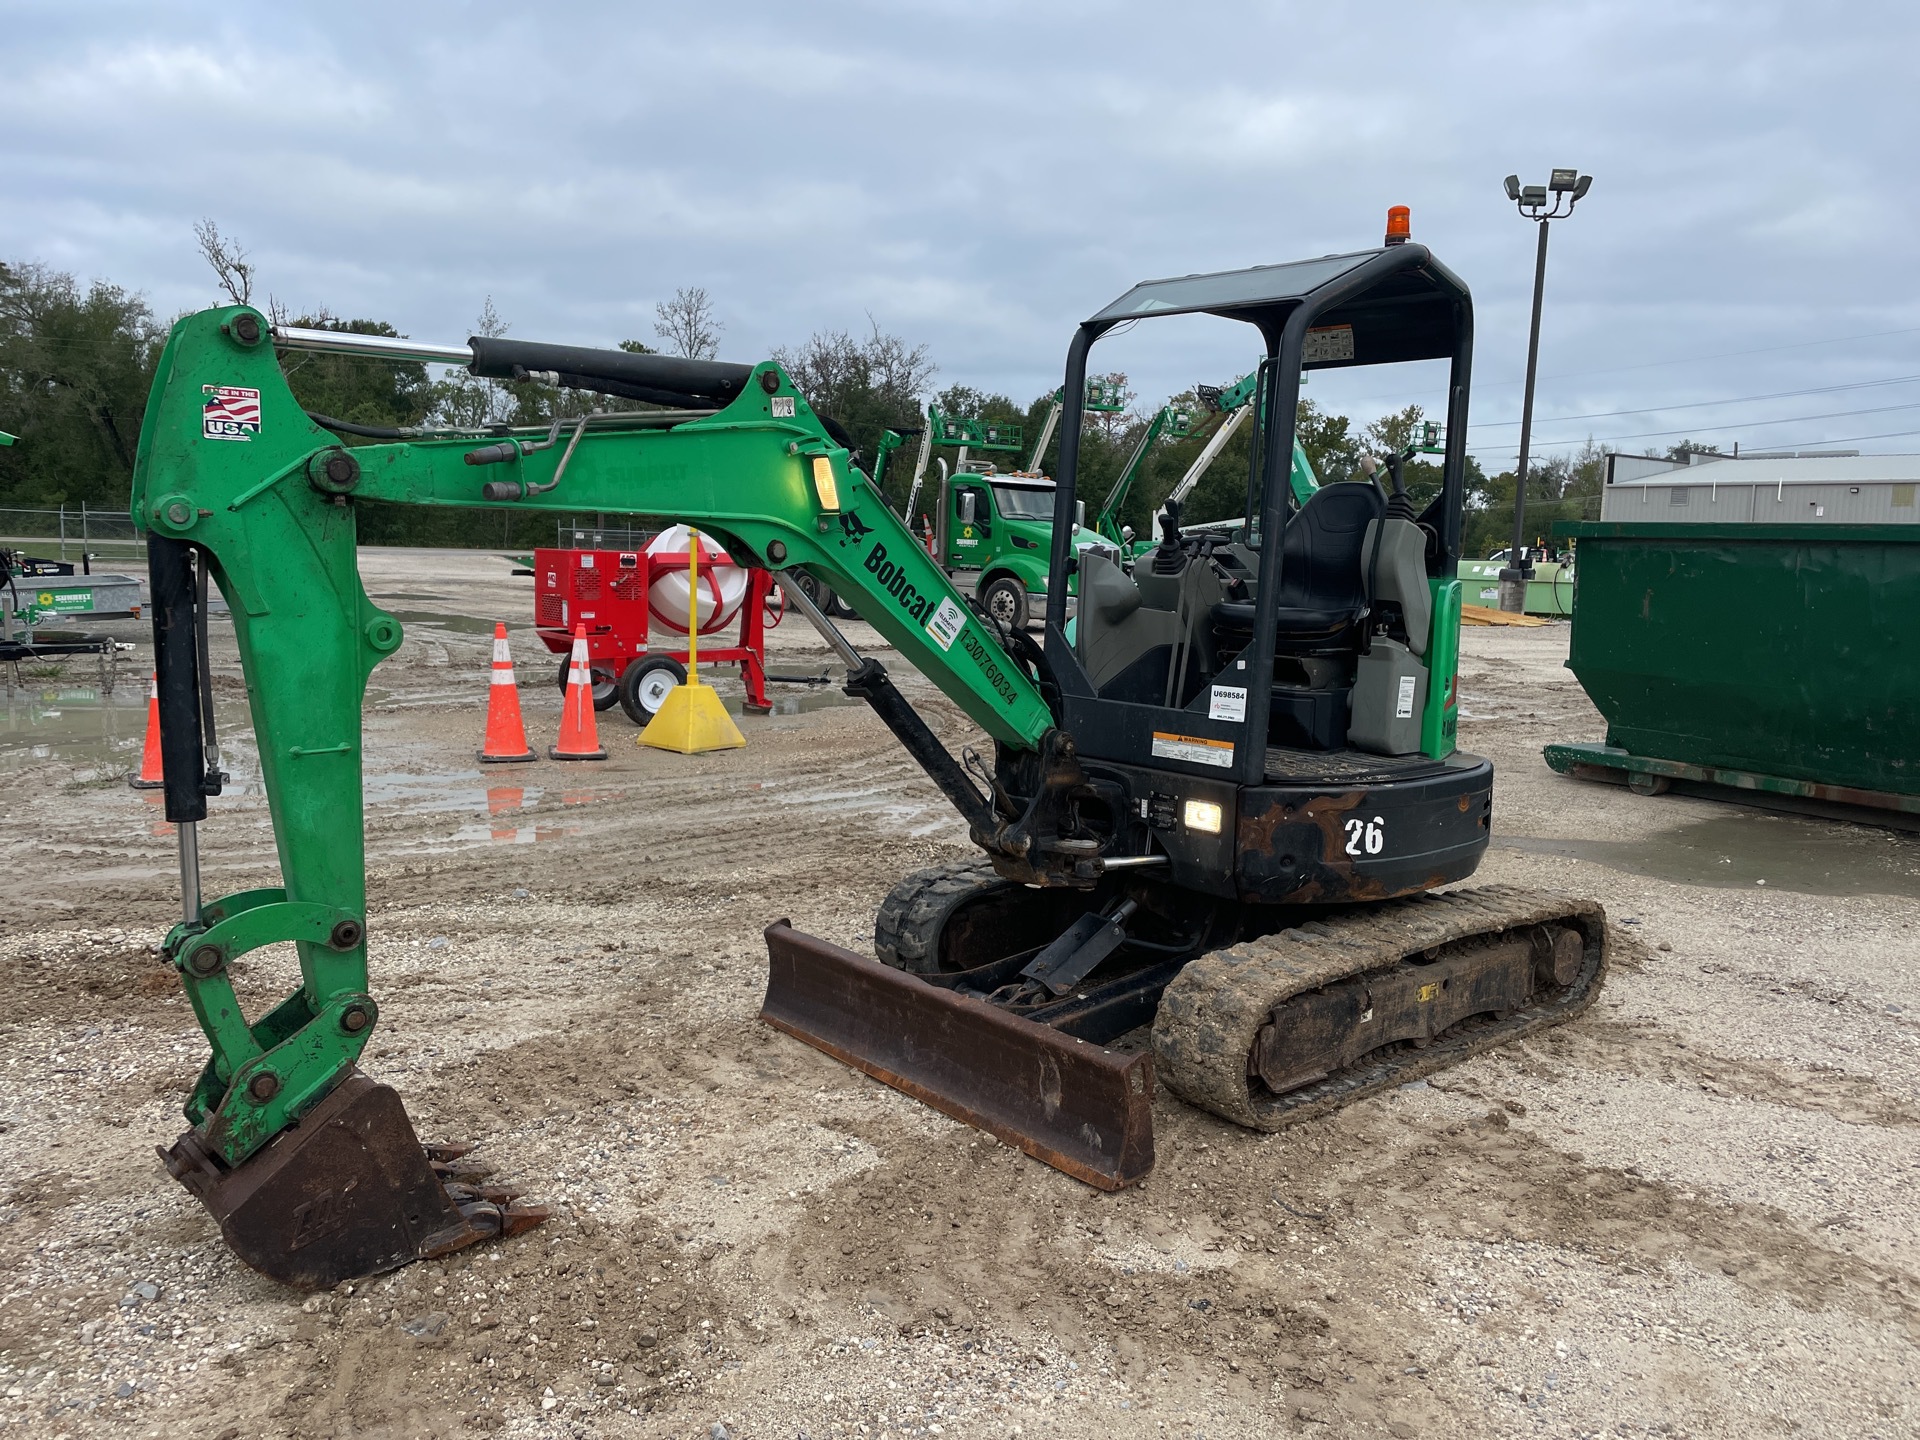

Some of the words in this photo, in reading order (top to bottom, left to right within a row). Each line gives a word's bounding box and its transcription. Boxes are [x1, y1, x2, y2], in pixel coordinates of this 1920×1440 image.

[207, 420, 255, 436] USA
[863, 541, 936, 628] Bobcat
[938, 611, 958, 634] TELEMATICS
[1213, 690, 1245, 700] U698584
[1183, 736, 1208, 745] WARNING
[1344, 815, 1385, 856] 26
